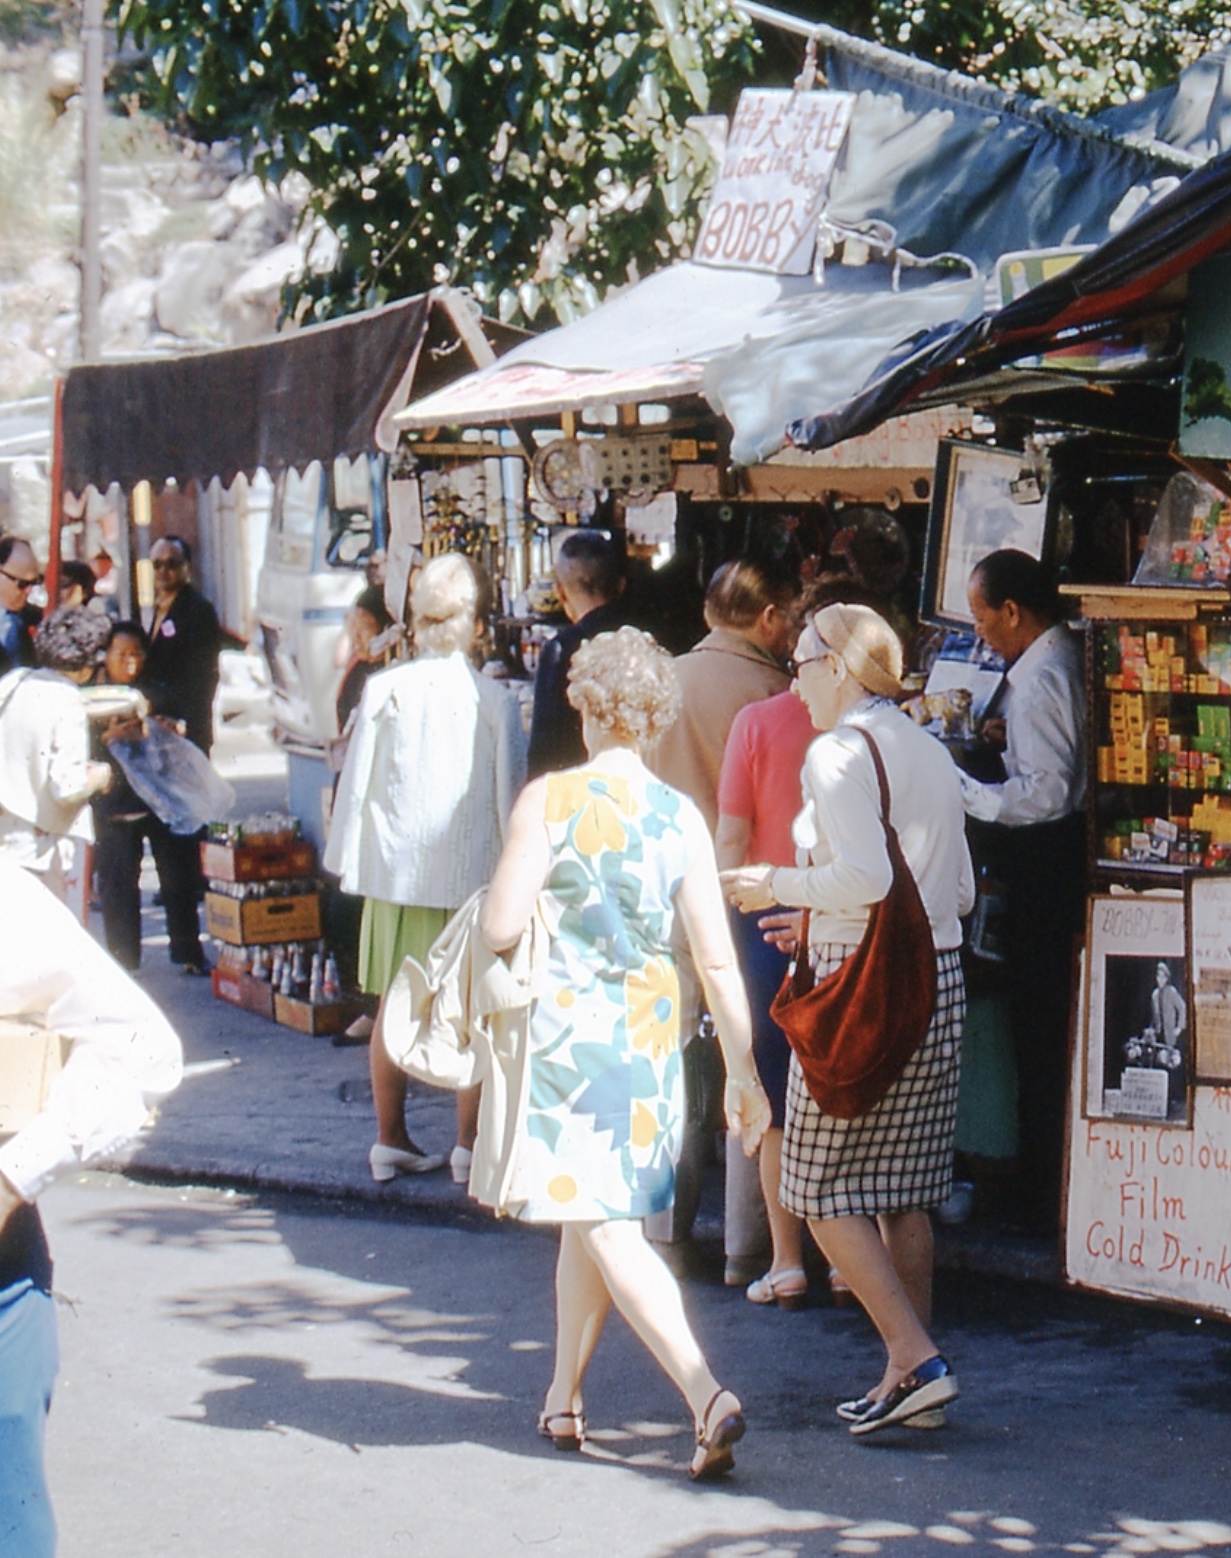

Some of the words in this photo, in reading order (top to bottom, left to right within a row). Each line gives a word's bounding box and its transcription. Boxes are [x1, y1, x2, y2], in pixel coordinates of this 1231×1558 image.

[700, 198, 820, 270] BOBBY
[1086, 1121, 1147, 1177] Fuji
[1120, 1176, 1187, 1221] Film
[1086, 1220, 1144, 1268] Cold
